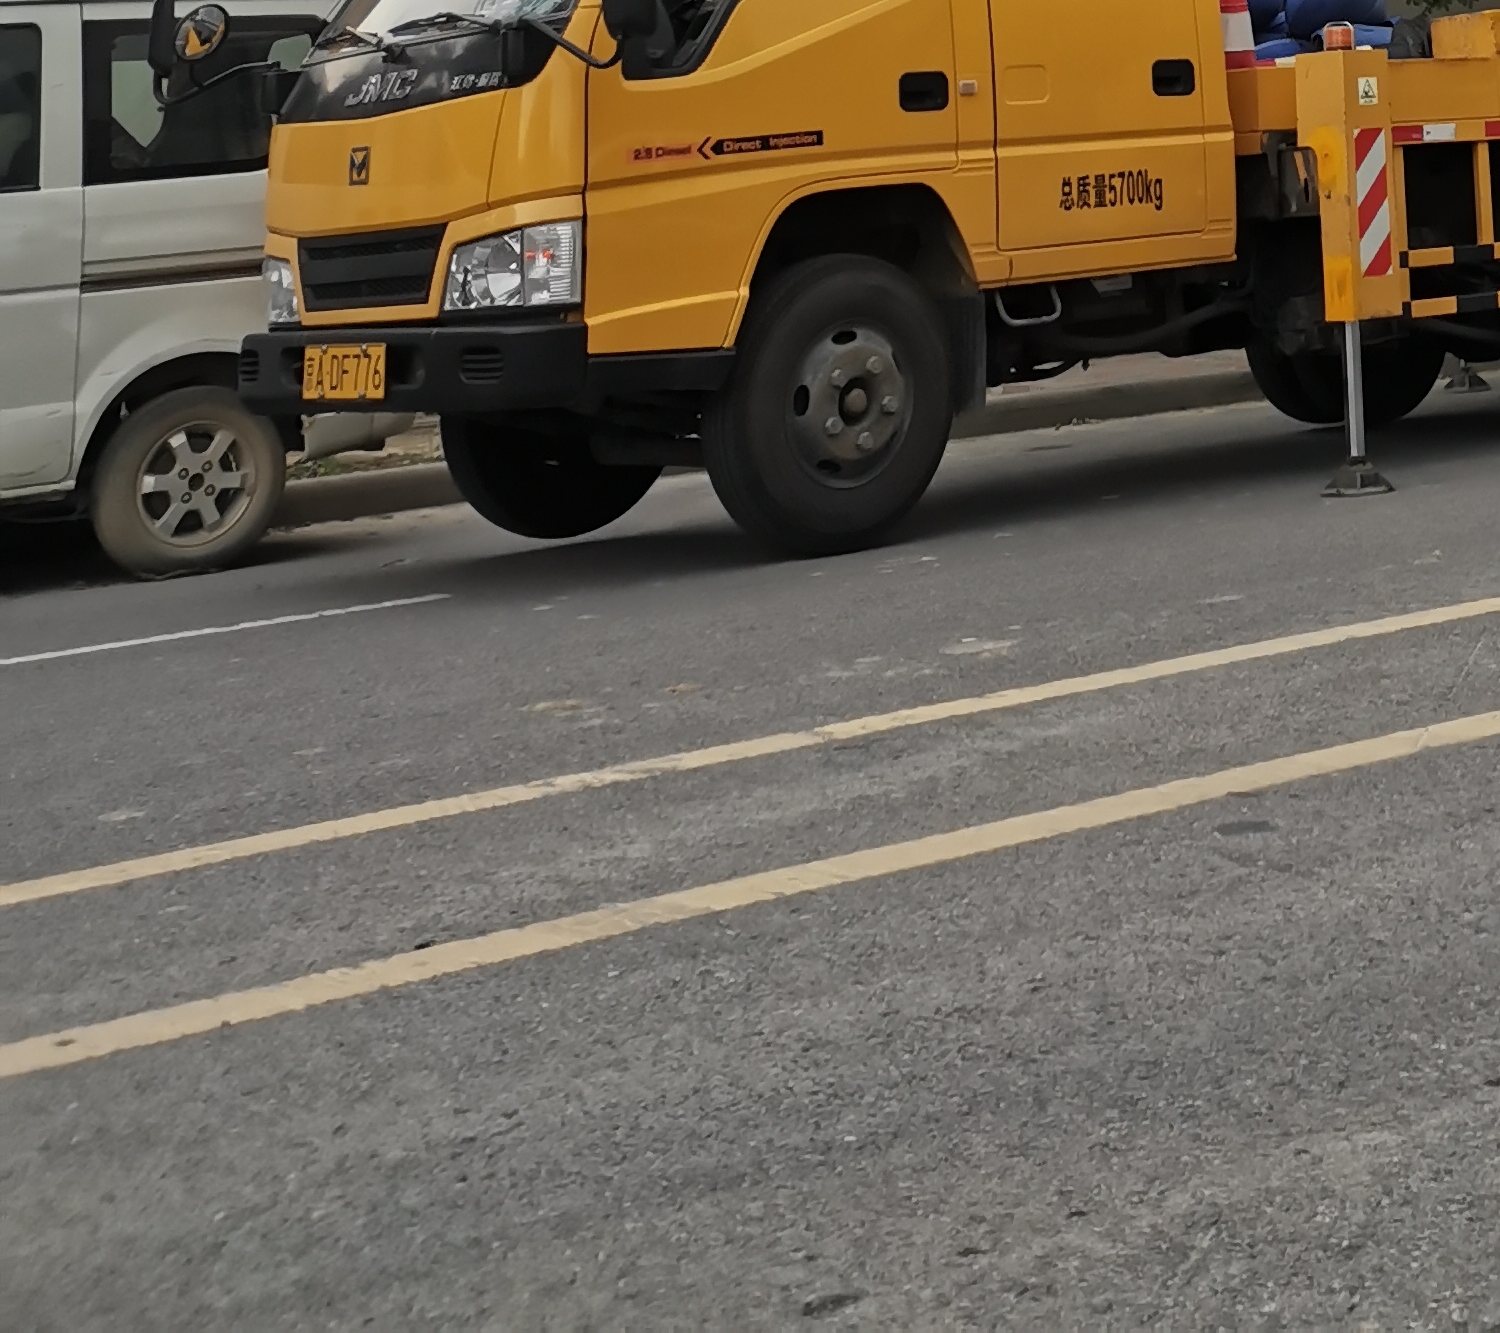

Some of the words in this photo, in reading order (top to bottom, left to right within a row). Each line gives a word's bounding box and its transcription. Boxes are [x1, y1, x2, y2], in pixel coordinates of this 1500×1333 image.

[344, 68, 418, 107] JMC
[722, 139, 762, 153] Direct
[768, 133, 818, 148] Injection
[1059, 169, 1163, 211] 总质量5700kg
